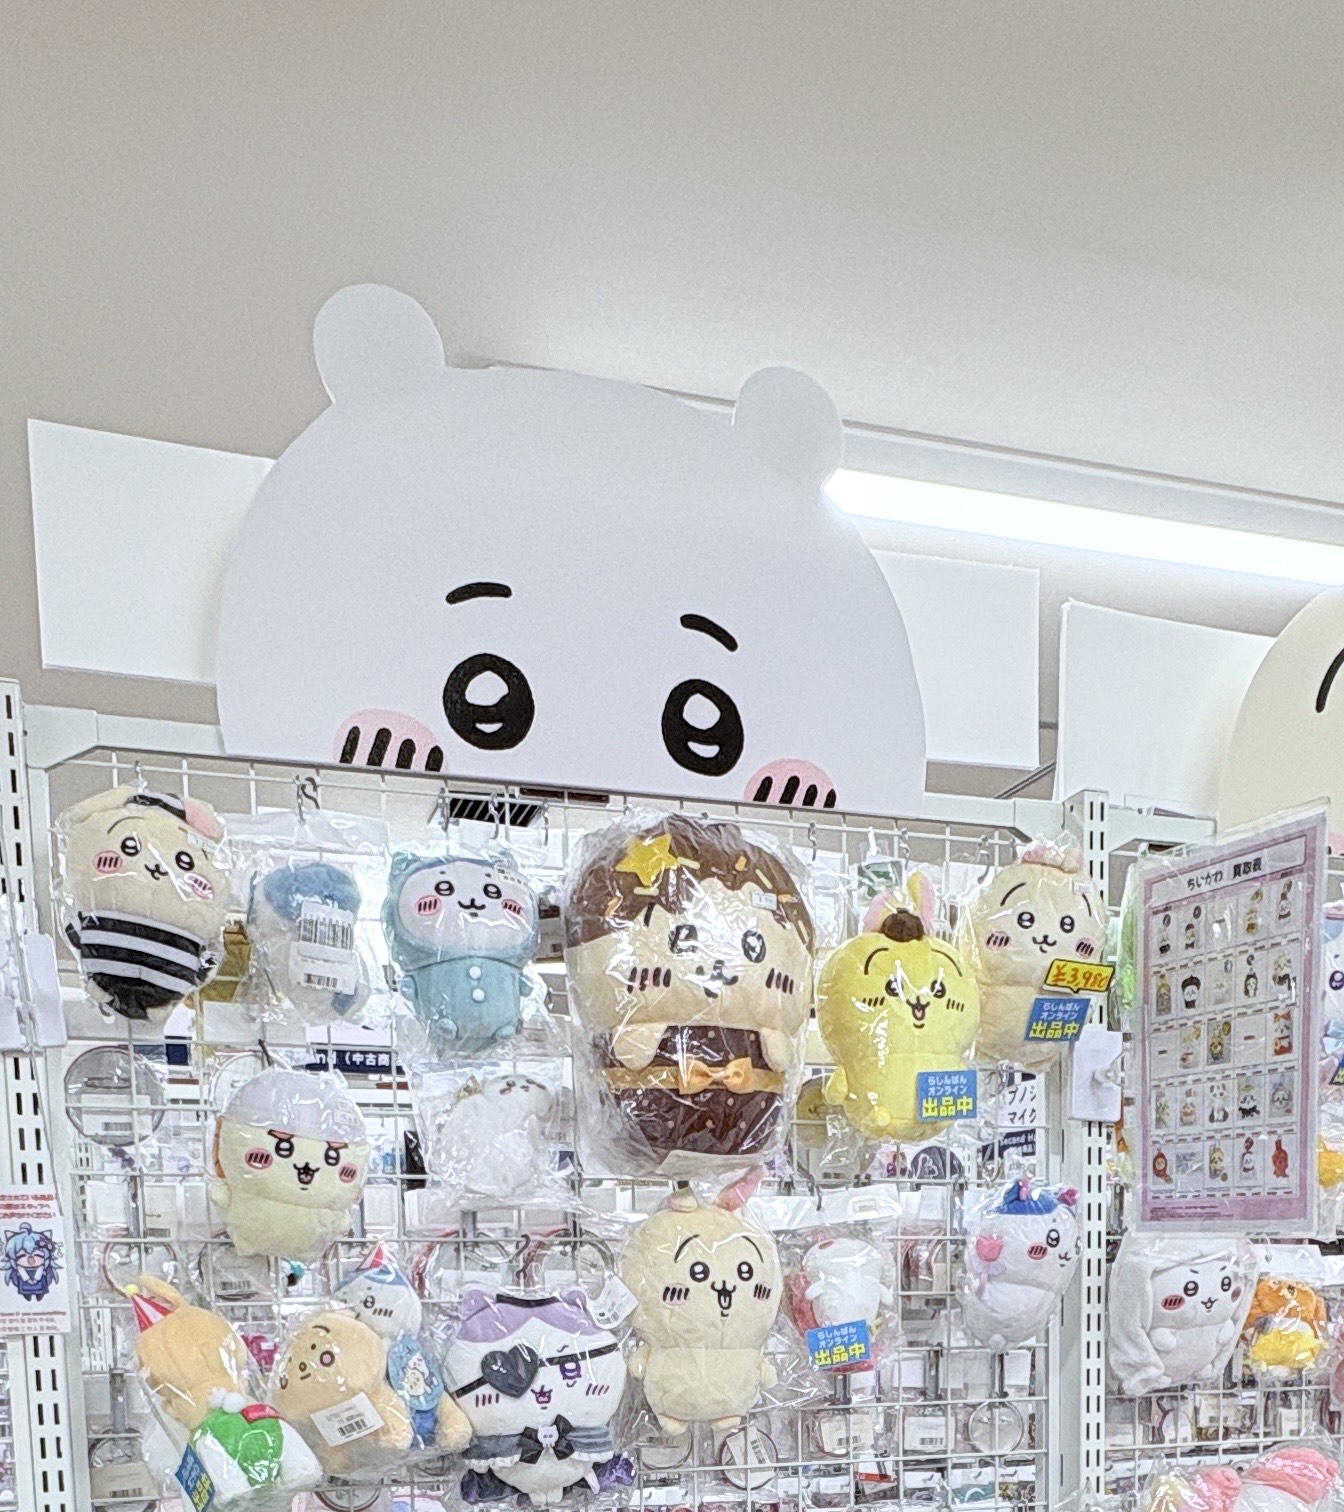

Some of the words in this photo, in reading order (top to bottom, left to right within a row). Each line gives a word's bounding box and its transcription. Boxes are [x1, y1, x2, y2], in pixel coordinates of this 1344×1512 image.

[1029, 1022, 1080, 1039] 出品中
[927, 1084, 968, 1096] オンライン
[922, 1097, 973, 1118] 出品中
[814, 1342, 866, 1366] 出品中
